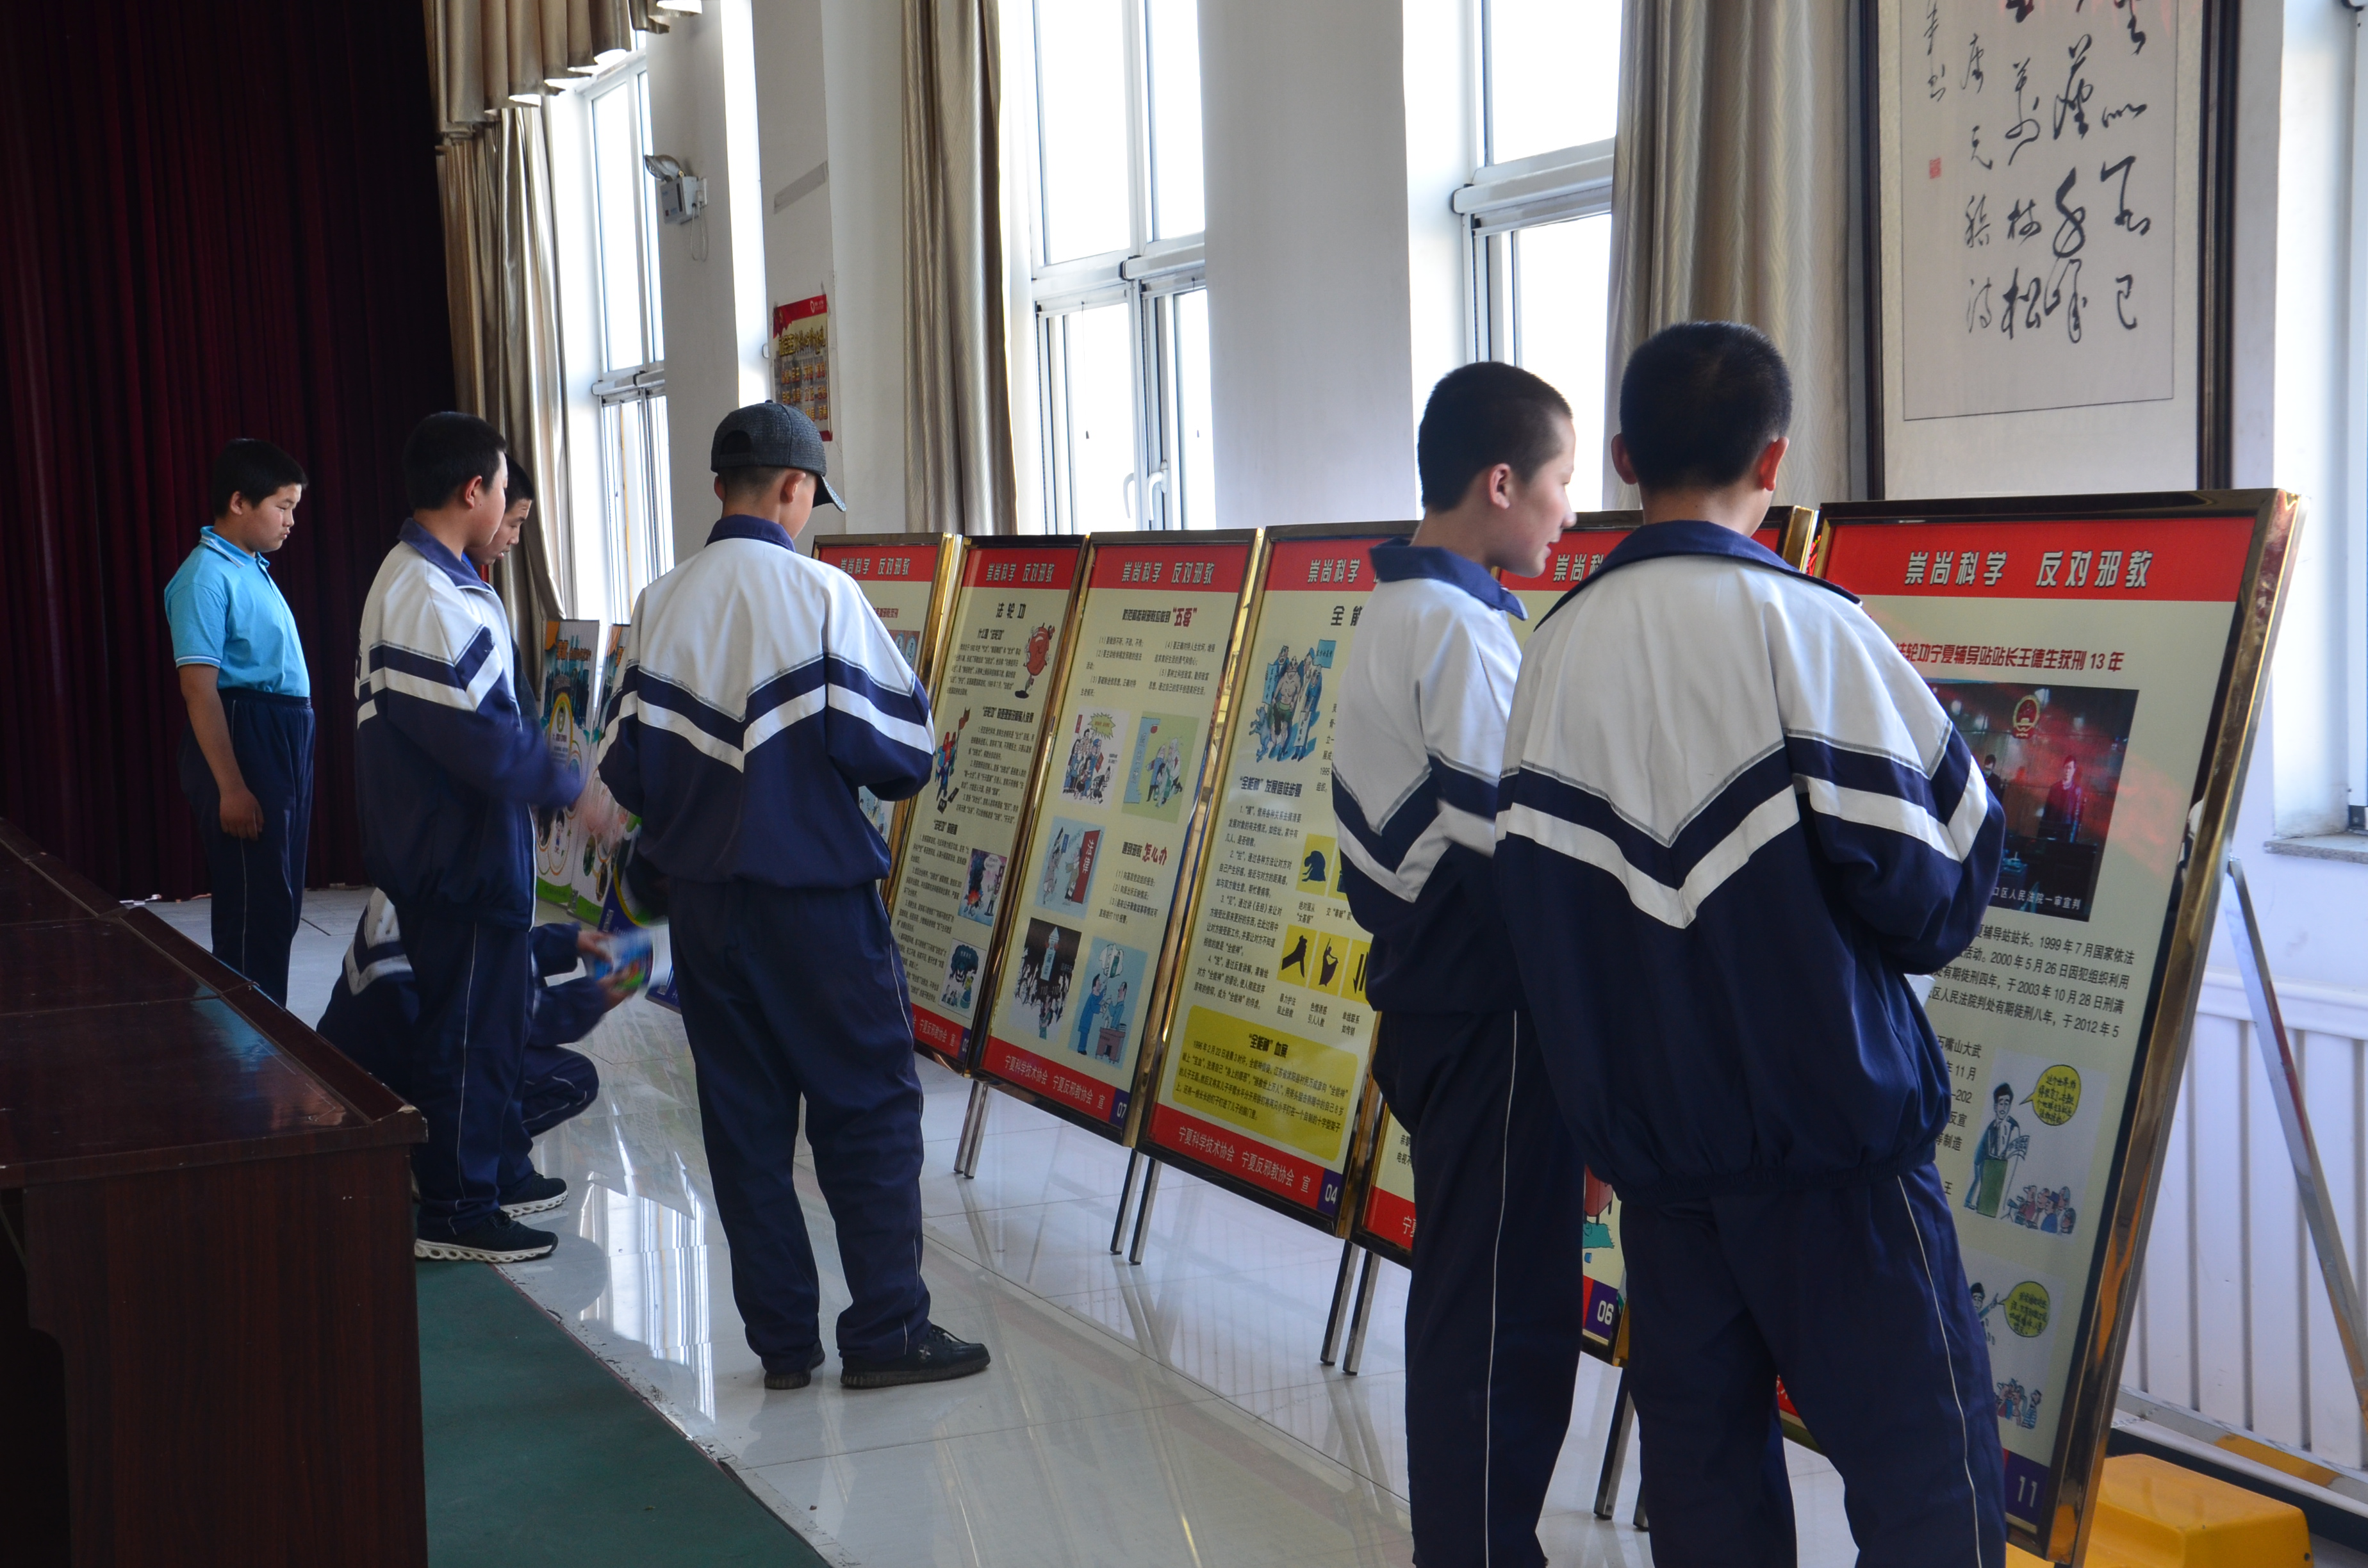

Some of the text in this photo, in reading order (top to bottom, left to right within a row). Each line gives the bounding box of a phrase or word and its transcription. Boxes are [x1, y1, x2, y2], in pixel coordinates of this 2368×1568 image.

[840, 557, 910, 576] 崇尚科学 反对邪教
[986, 563, 1055, 584] 崇尚科学 反对邪教
[1121, 562, 1215, 585] 崇尚科学 反对邪教
[1308, 559, 1361, 584] 崇尚科学
[1904, 550, 2153, 588] 崇尚科学 反对邪教
[996, 602, 1026, 619] 法轮功
[1928, 986, 2120, 1038] 区人民法院判处有期徒刑八年，于2012年5
[1005, 1054, 1106, 1109] 宁夏科学技术协会 宁夏反邪教协会 宣
[1117, 1102, 1127, 1119] 07
[1178, 1125, 1311, 1193] 宁夏科学技术协会 宁夏反邪教协会 宣
[1325, 1184, 1339, 1204] 04
[1597, 1300, 1614, 1325] 06
[2017, 1475, 2038, 1508] 11
